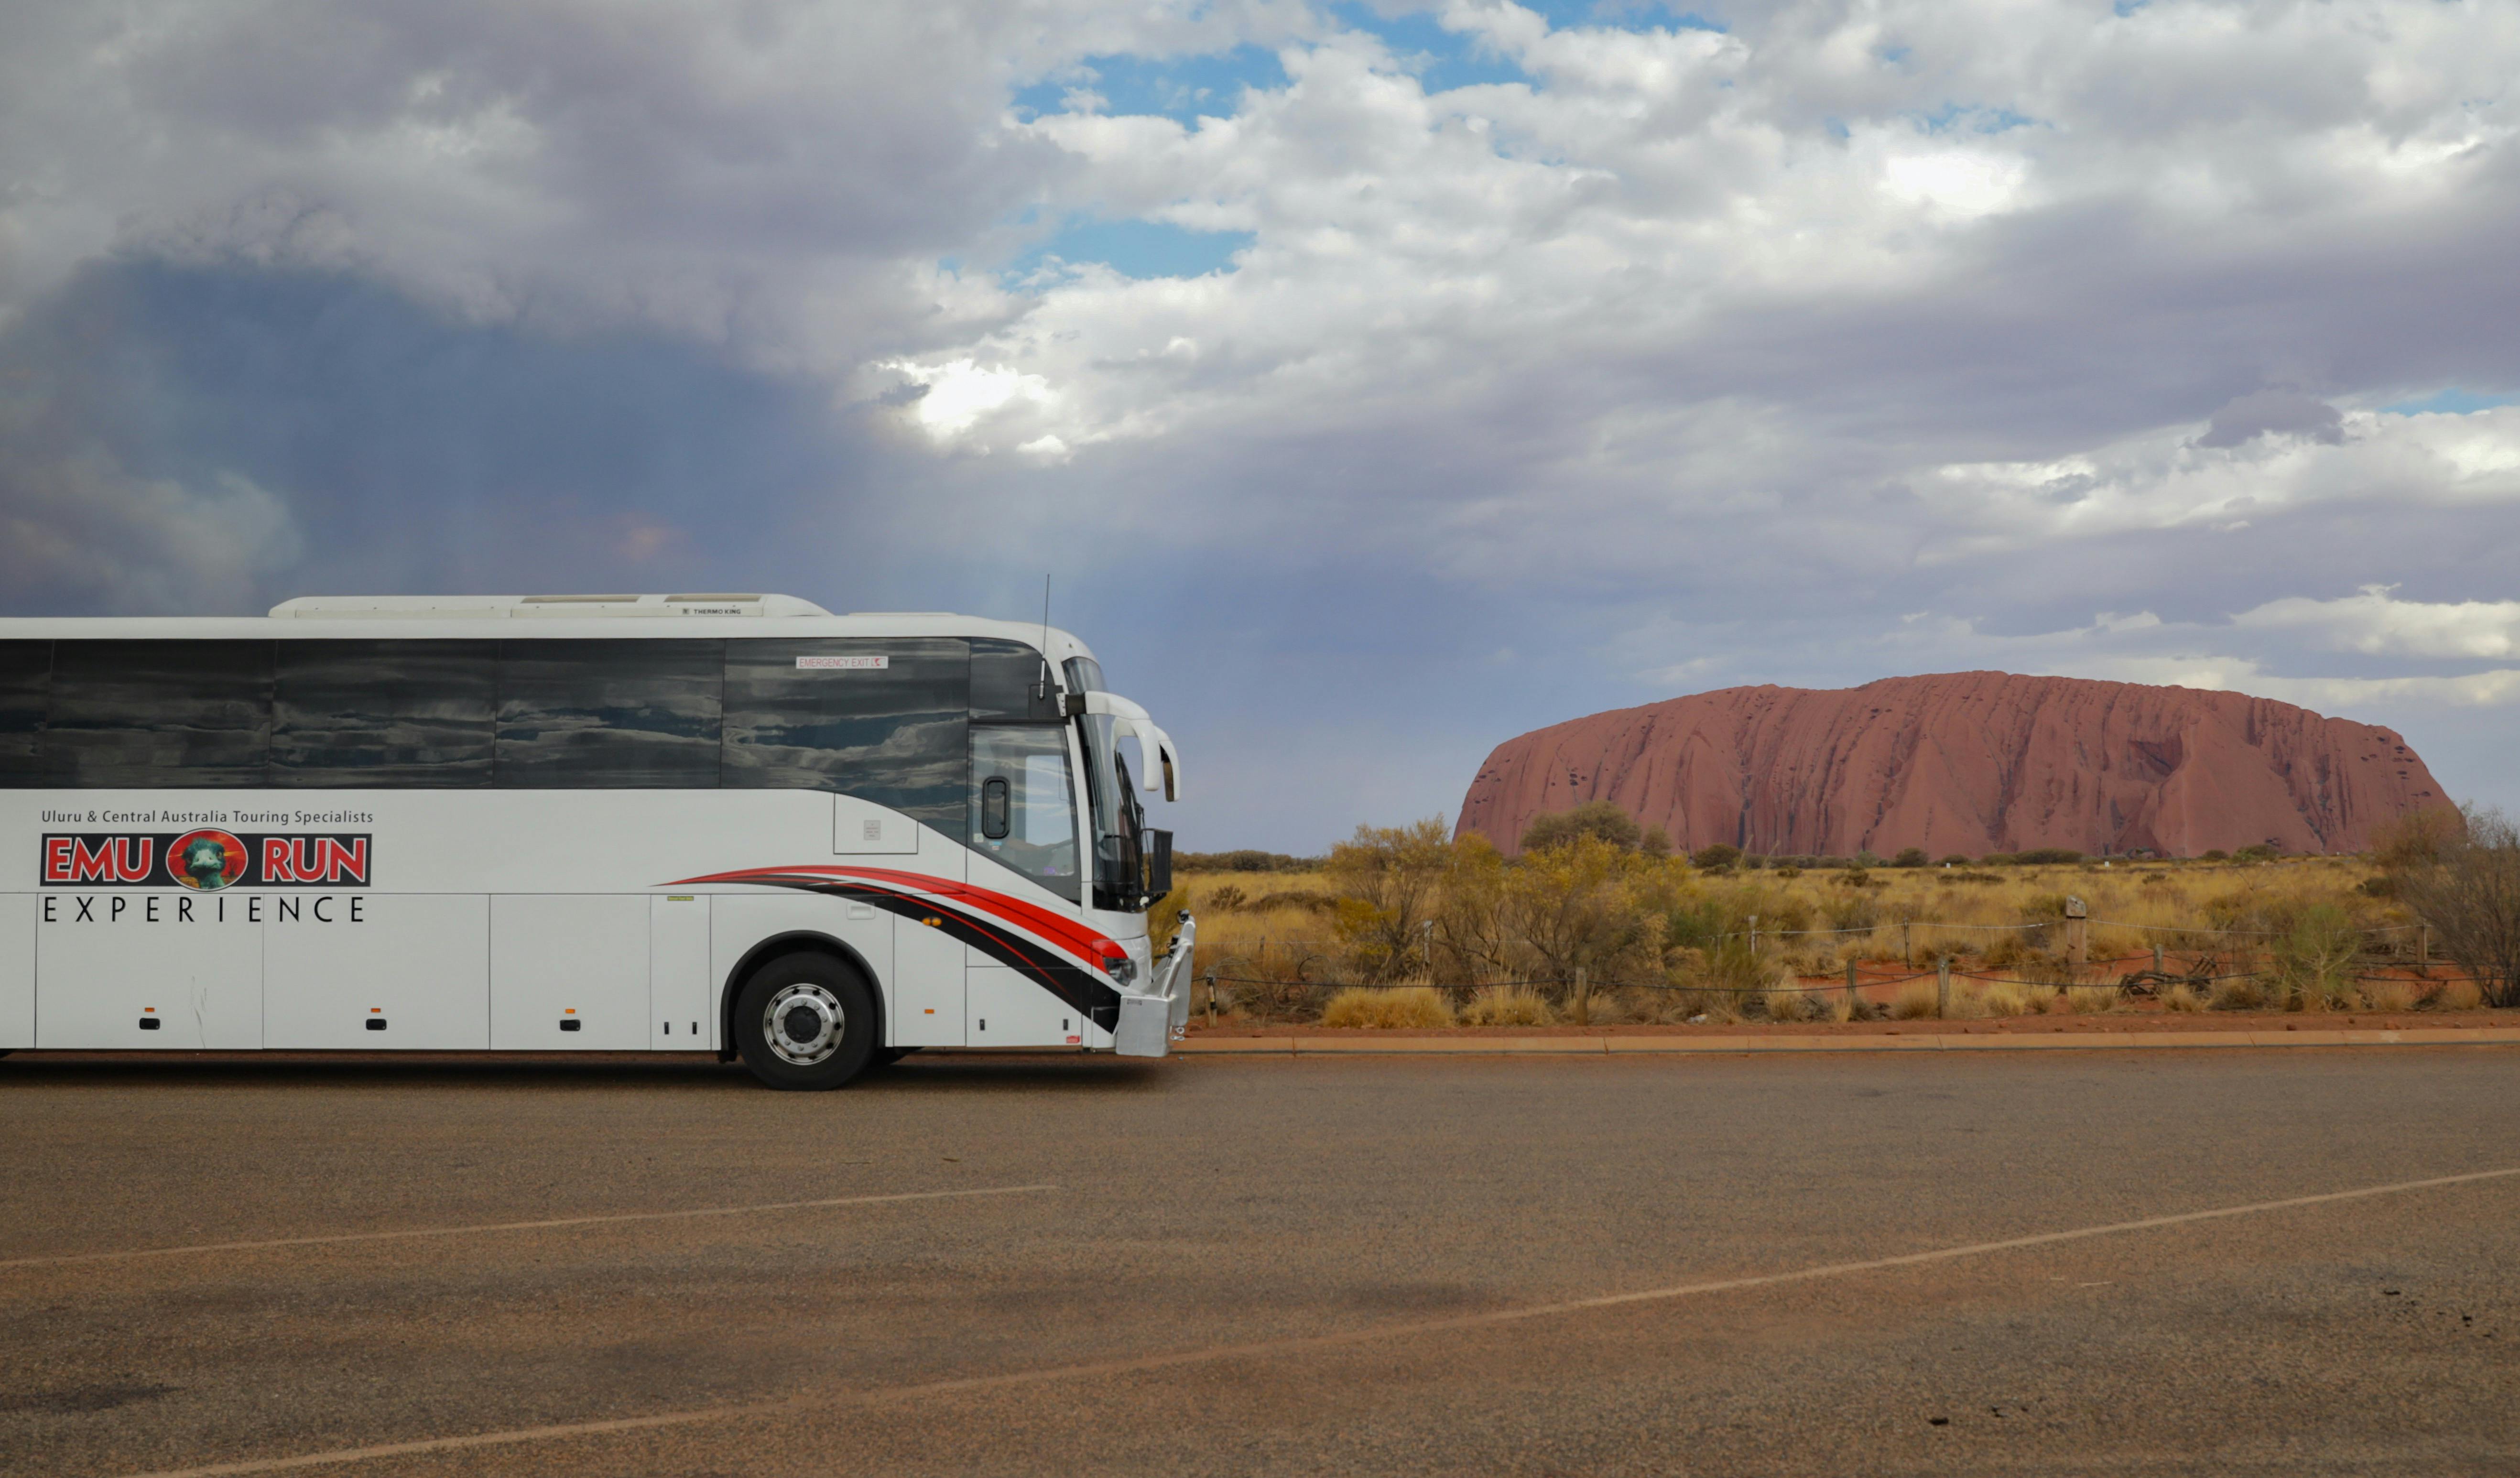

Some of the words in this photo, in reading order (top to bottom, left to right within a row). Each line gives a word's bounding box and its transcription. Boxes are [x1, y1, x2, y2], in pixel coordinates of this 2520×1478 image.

[799, 658, 849, 667] EMERGENCY
[852, 658, 869, 667] EXIT
[42, 810, 82, 823] Uluru
[87, 810, 97, 823] &
[102, 810, 155, 823] Central
[161, 810, 227, 823] Australia
[233, 810, 289, 826] Touring
[294, 810, 373, 826] Specialists
[46, 838, 152, 881] EMU
[263, 838, 365, 881] RUN
[44, 897, 363, 922] EXPERIENCE
